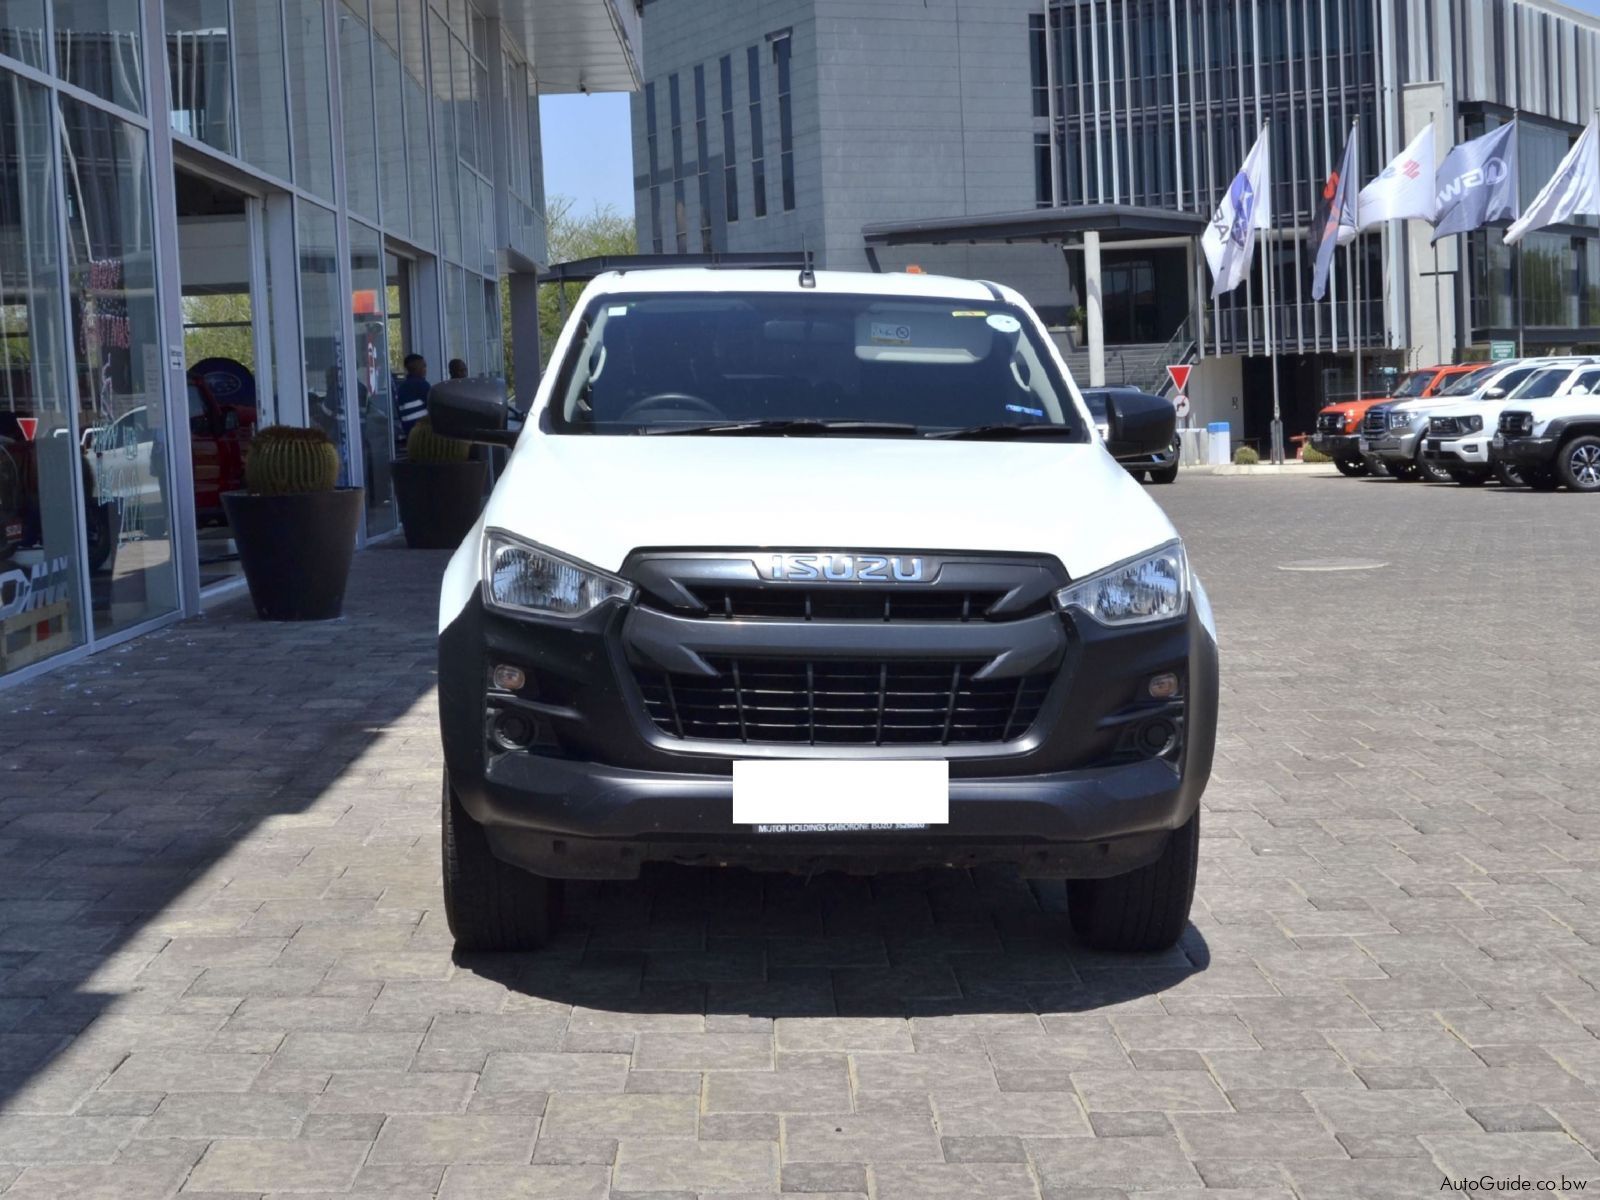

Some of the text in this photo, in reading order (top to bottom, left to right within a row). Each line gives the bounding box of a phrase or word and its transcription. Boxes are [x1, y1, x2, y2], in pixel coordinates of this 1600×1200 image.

[772, 555, 922, 581] ISUZU
[758, 824, 787, 833] MOTOR
[788, 823, 827, 832] HOLDINGS
